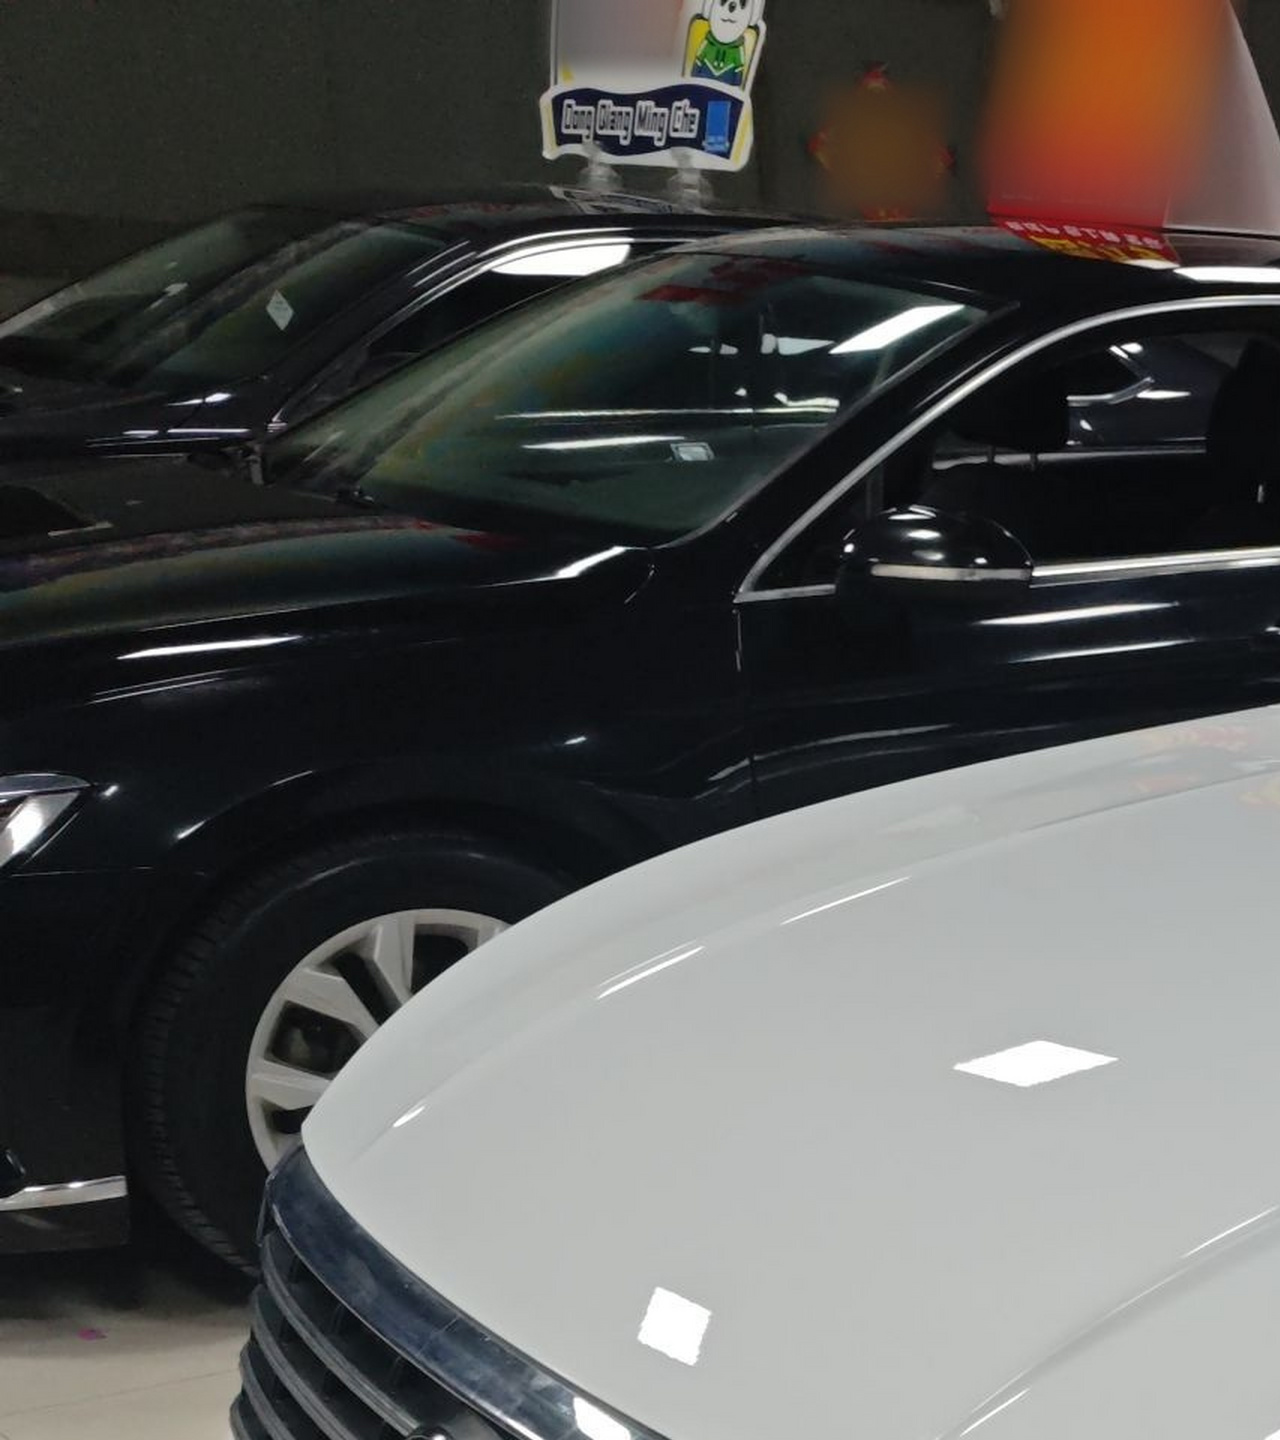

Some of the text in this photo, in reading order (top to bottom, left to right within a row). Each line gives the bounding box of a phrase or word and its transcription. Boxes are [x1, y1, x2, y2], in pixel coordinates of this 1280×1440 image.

[562, 99, 595, 142] Dong
[634, 100, 668, 146] Ming
[669, 98, 700, 138] Che
